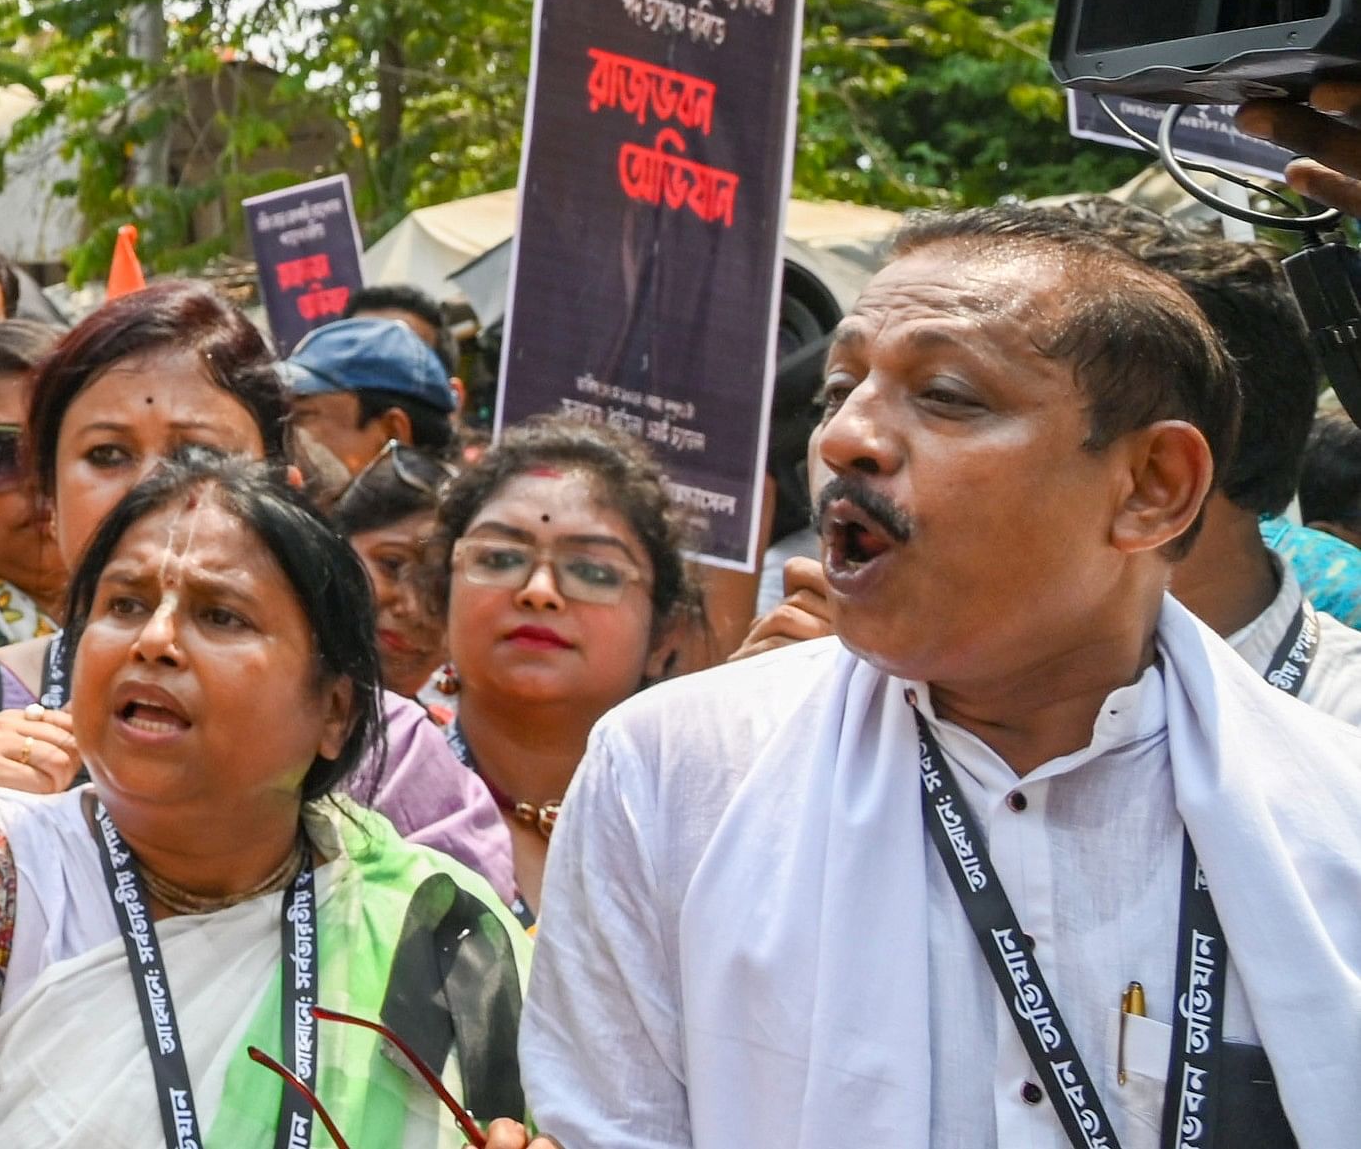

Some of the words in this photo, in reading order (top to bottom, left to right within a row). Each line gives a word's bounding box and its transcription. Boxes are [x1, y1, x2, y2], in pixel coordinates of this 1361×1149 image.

[587, 47, 716, 136] রাজভবন
[617, 128, 740, 228] অভিযান
[115, 865, 158, 965] সর্বভারতীয়
[287, 888, 317, 989] সর্বভারতীয়
[990, 927, 1062, 1054] অভিযান
[1178, 929, 1216, 1055] অভিযান
